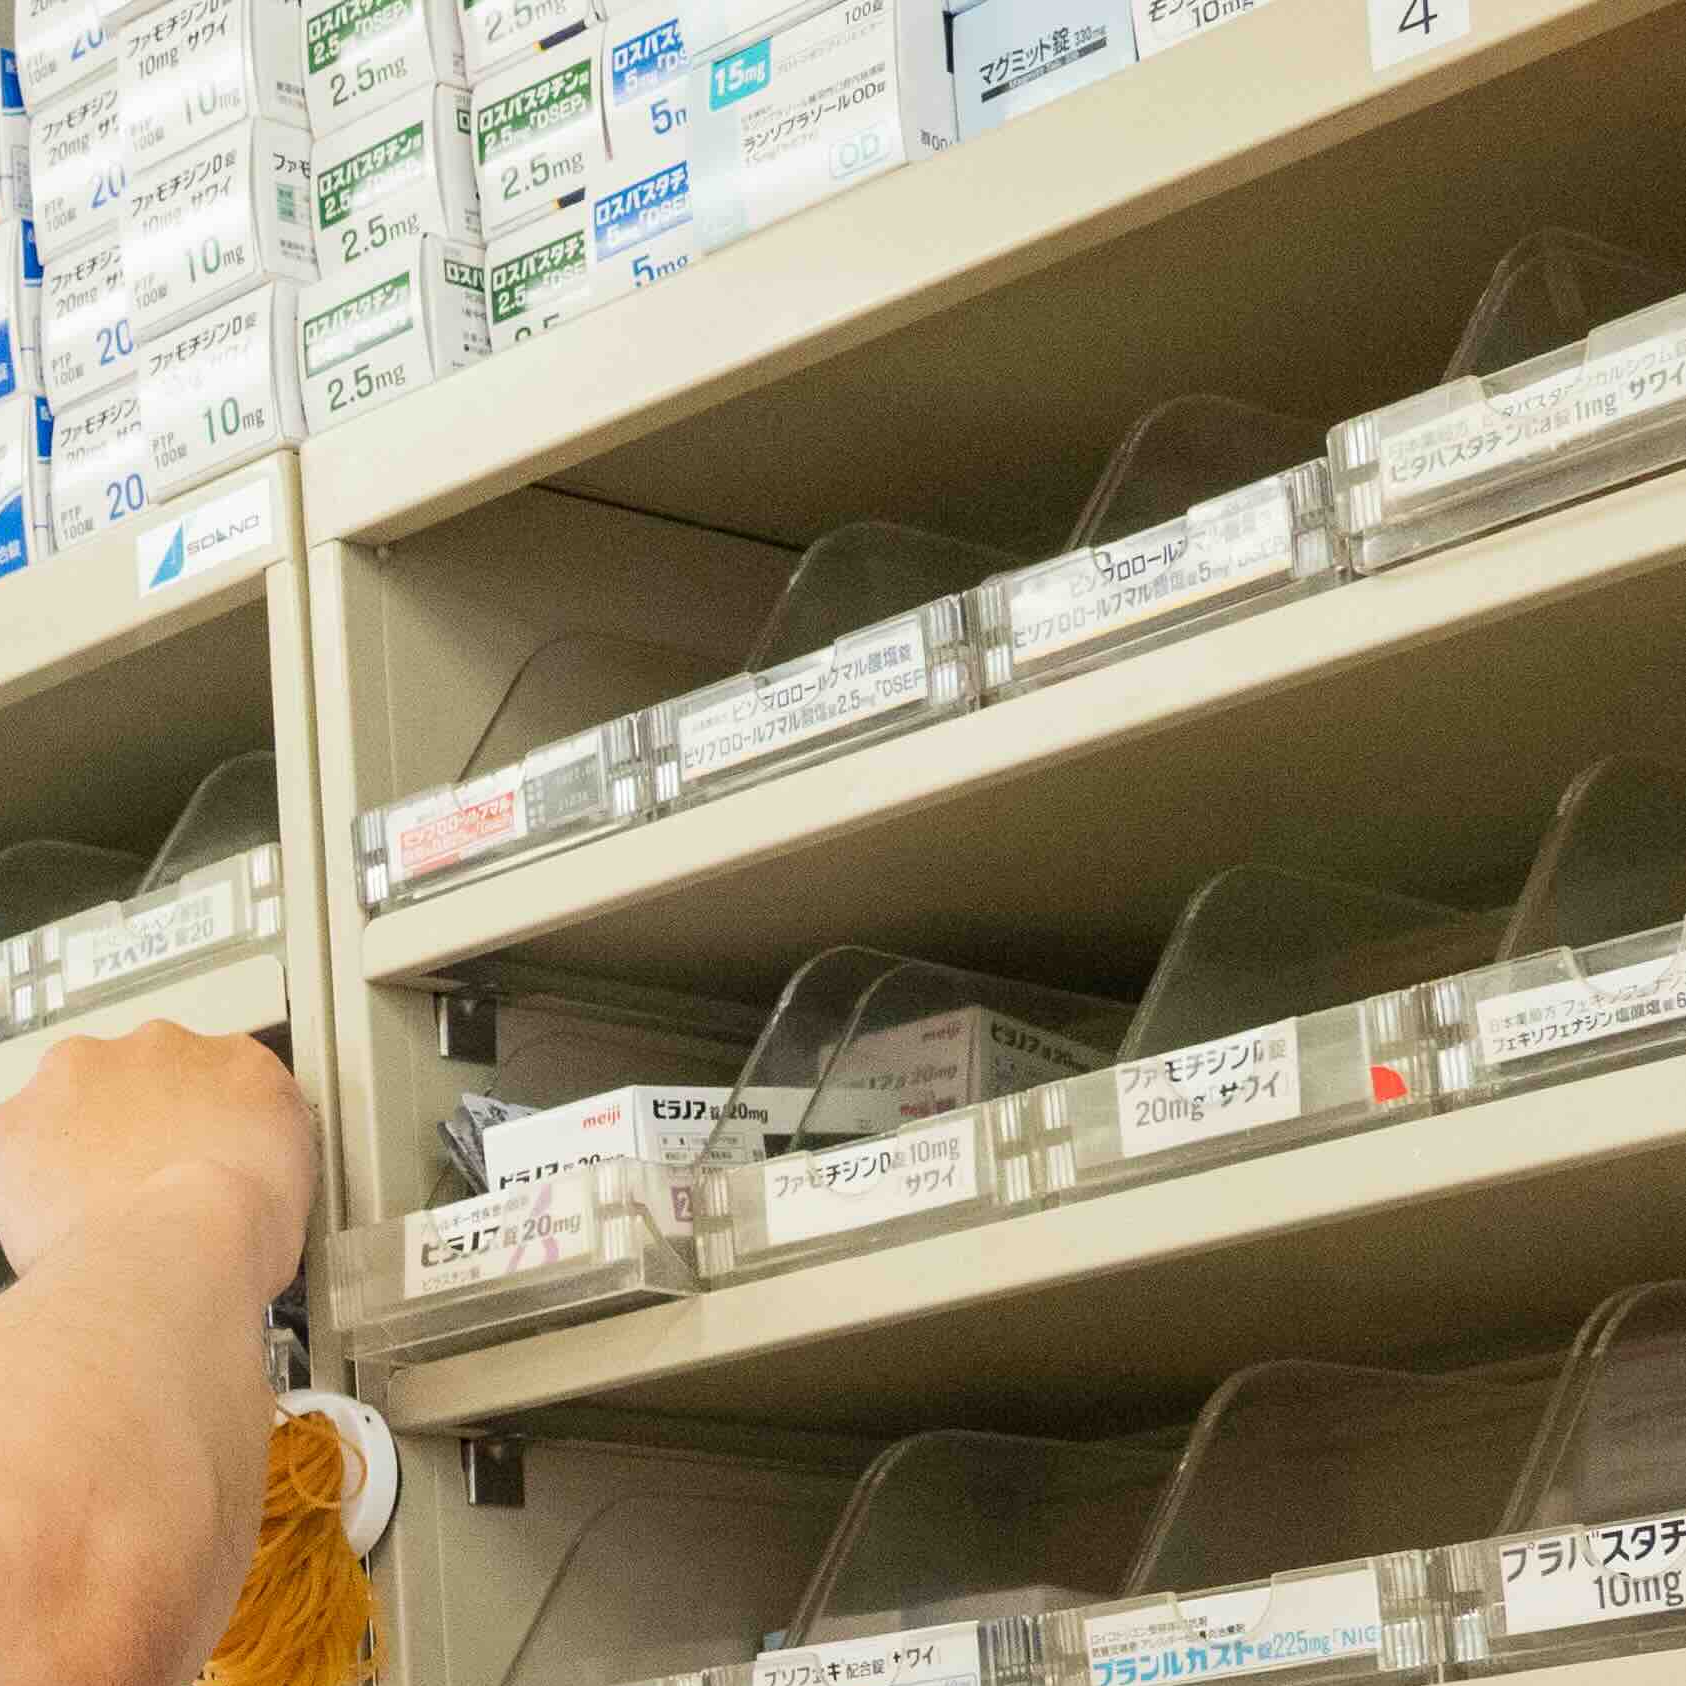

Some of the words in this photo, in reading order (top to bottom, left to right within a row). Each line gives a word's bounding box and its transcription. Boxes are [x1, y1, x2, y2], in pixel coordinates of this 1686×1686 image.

[329, 55, 409, 109] 2.5mg
[713, 60, 767, 99] 15mg
[500, 151, 586, 203] 2.5mg
[184, 235, 246, 286] 10mg
[340, 212, 422, 264] 2.5mg
[94, 317, 136, 368] 20
[325, 362, 408, 413] 2.5mg
[202, 395, 267, 447] 10mg
[104, 471, 146, 522] 20
[581, 1105, 622, 1129] meiji
[1135, 1093, 1206, 1128] 20mg
[1593, 1571, 1685, 1611] 10mg
